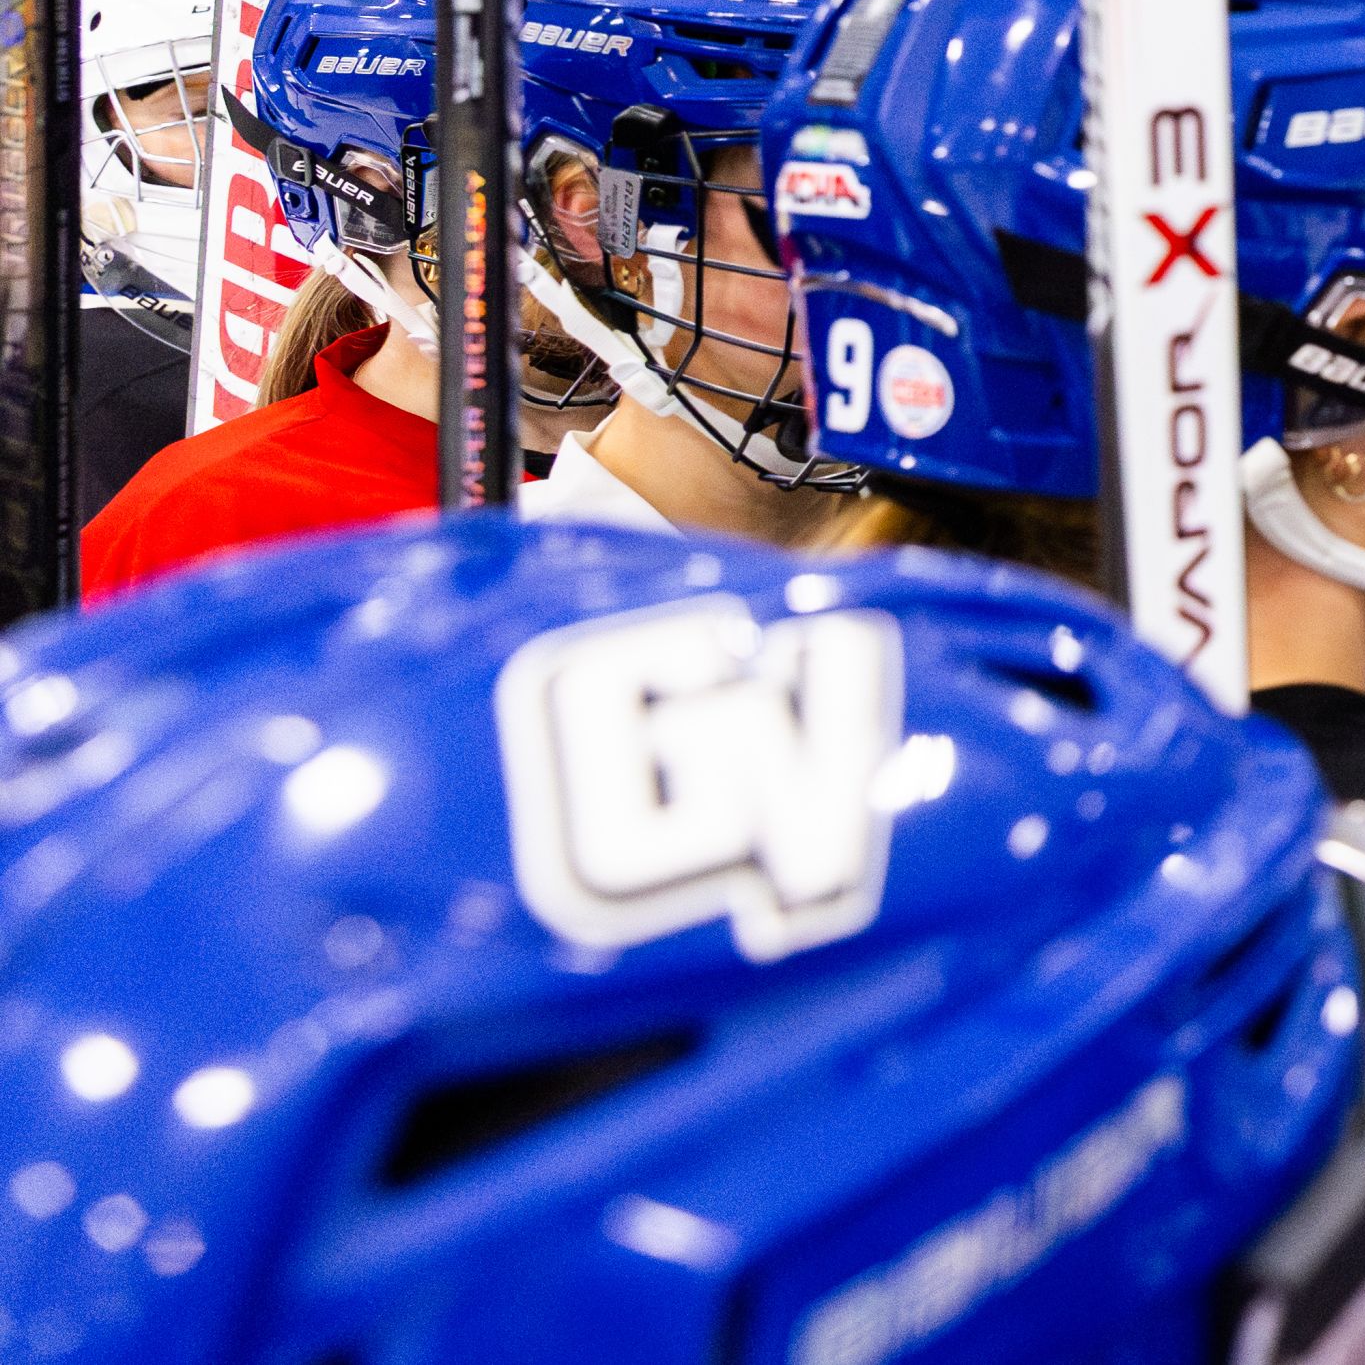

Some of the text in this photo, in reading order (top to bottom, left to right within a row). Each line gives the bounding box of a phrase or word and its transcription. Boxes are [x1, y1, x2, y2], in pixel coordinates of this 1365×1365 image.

[521, 20, 634, 58] BAUER
[316, 53, 427, 76] BAUER
[405, 166, 417, 225] BAUER
[825, 317, 874, 433] 9
